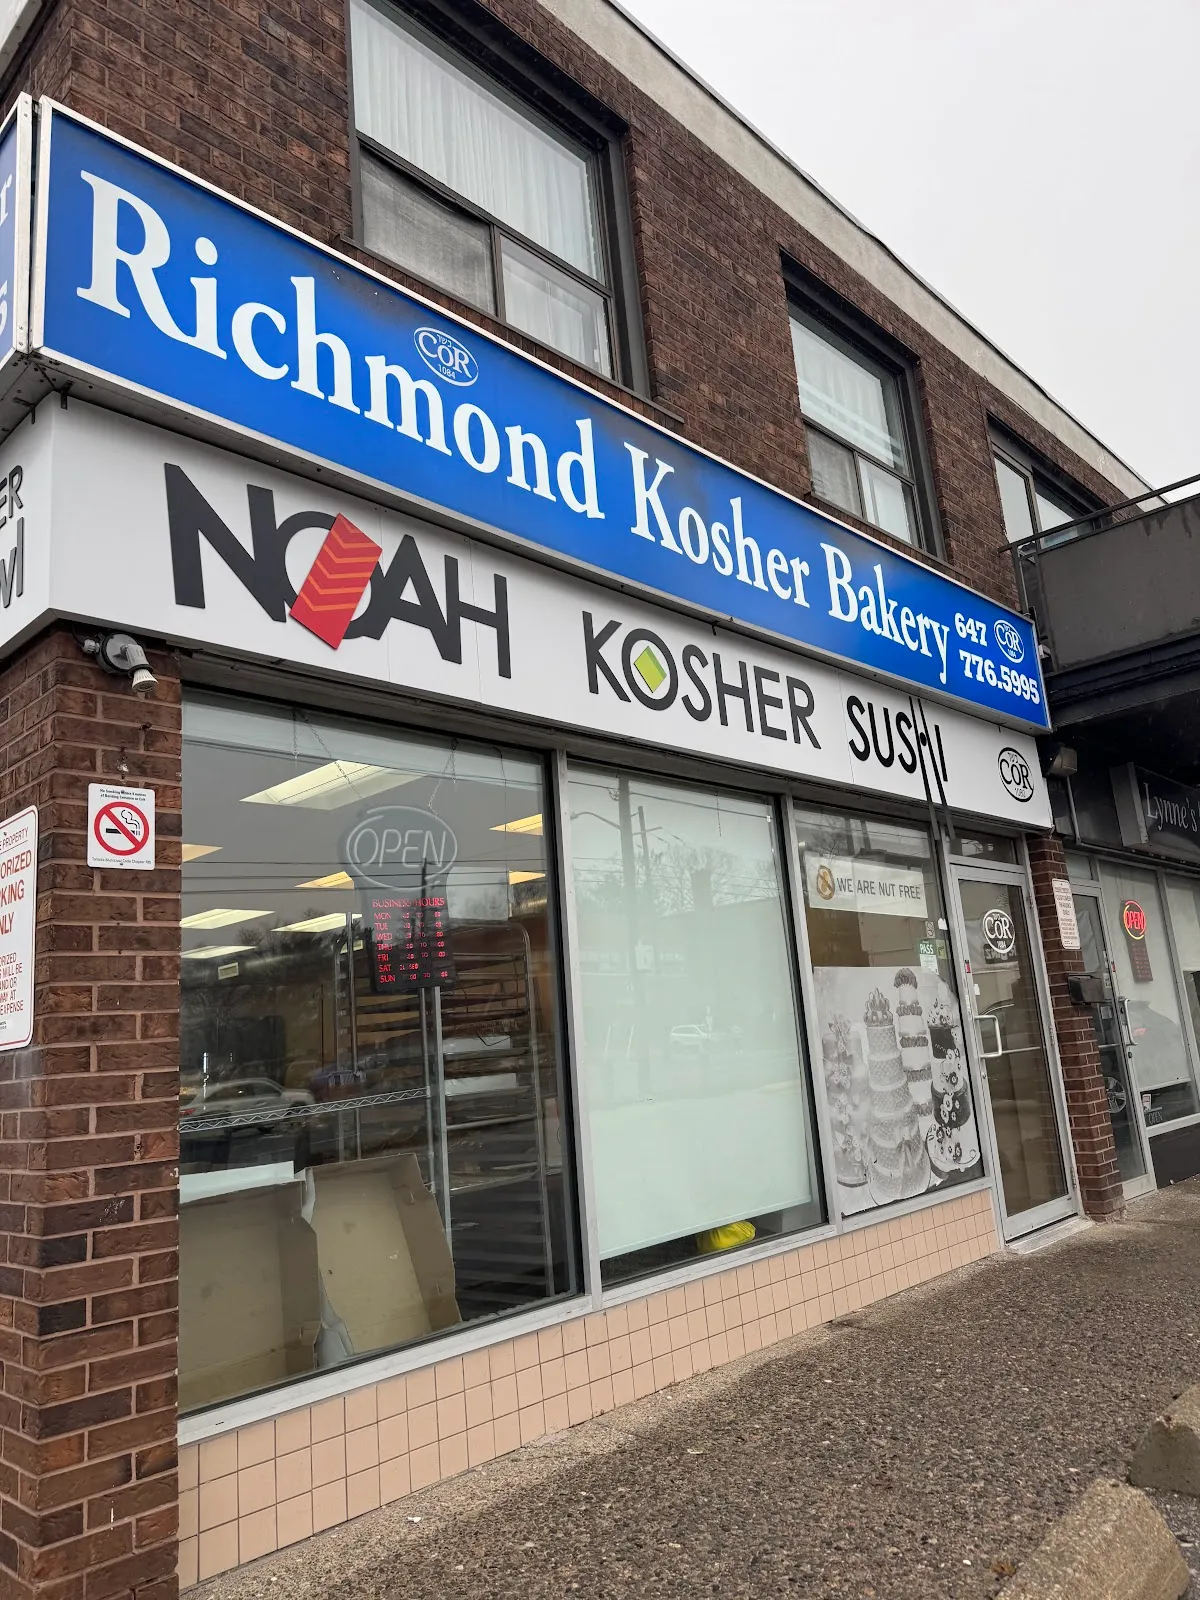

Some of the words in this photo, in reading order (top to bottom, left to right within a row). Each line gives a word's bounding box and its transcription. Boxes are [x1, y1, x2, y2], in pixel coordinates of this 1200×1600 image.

[438, 363, 456, 379] 1084
[76, 170, 606, 520] Richmond
[623, 441, 811, 608] Kosher
[820, 542, 950, 684] Bakery
[164, 463, 511, 679] NOAH
[954, 612, 987, 647] 647
[959, 649, 1040, 705] 776.5995
[582, 610, 821, 749] KOSHER
[846, 696, 948, 786] SUSHI
[1143, 782, 1198, 832] Lynne's
[3, 827, 29, 849] PROPERTY
[353, 828, 447, 868] OPEN
[837, 877, 854, 893] WE
[857, 881, 876, 896] ARE
[878, 881, 896, 897] NUT
[898, 884, 921, 900] FREE
[372, 898, 411, 908] BUSINESS
[414, 897, 445, 907] HOURS
[374, 922, 388, 930] TUE
[1125, 911, 1145, 930] OPEN
[377, 943, 393, 951] THU
[920, 943, 934, 955] PASS
[378, 953, 389, 961] FRI
[15, 962, 23, 974] BE
[379, 964, 391, 973] SAT
[10, 976, 18, 989] OR
[380, 975, 396, 984] SUN
[10, 989, 16, 1001] AT
[0, 1000, 24, 1015] EXPENSE
